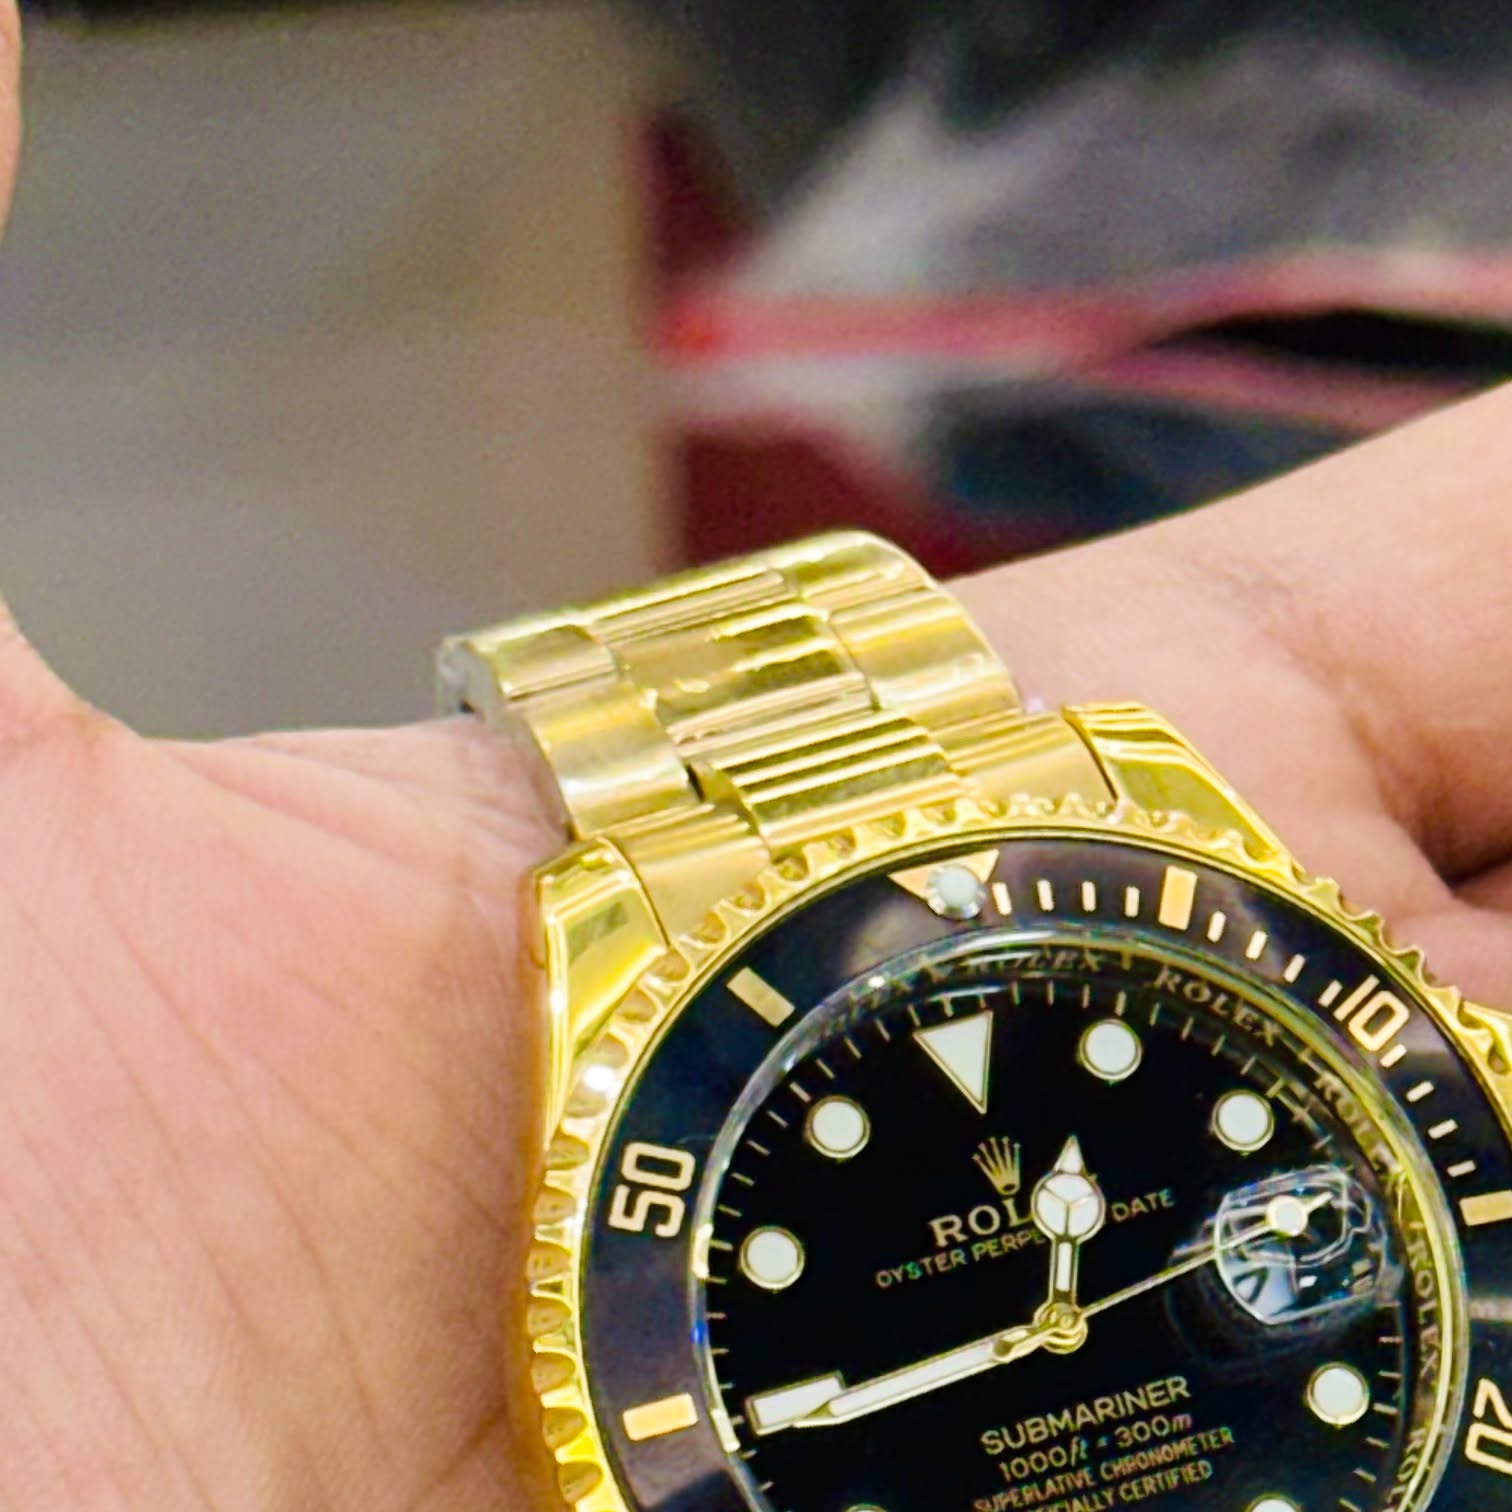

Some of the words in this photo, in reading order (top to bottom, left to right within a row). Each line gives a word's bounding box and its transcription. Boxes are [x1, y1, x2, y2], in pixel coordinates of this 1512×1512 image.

[1153, 963, 1283, 1048] ROLEX
[1332, 974, 1411, 1052] 10
[608, 1141, 697, 1238] 50
[928, 1196, 1033, 1248] ROL
[875, 1245, 969, 1289] OYSTER
[970, 1226, 1047, 1263] PERPE
[1110, 1186, 1175, 1223] DATE
[979, 1375, 1193, 1456] SUBMARINER
[998, 1435, 1090, 1483] 1000ft
[1113, 1412, 1193, 1449] 300m
[1099, 1425, 1236, 1481] CHRONOMETER
[1118, 1459, 1214, 1503] CERTIFIED
